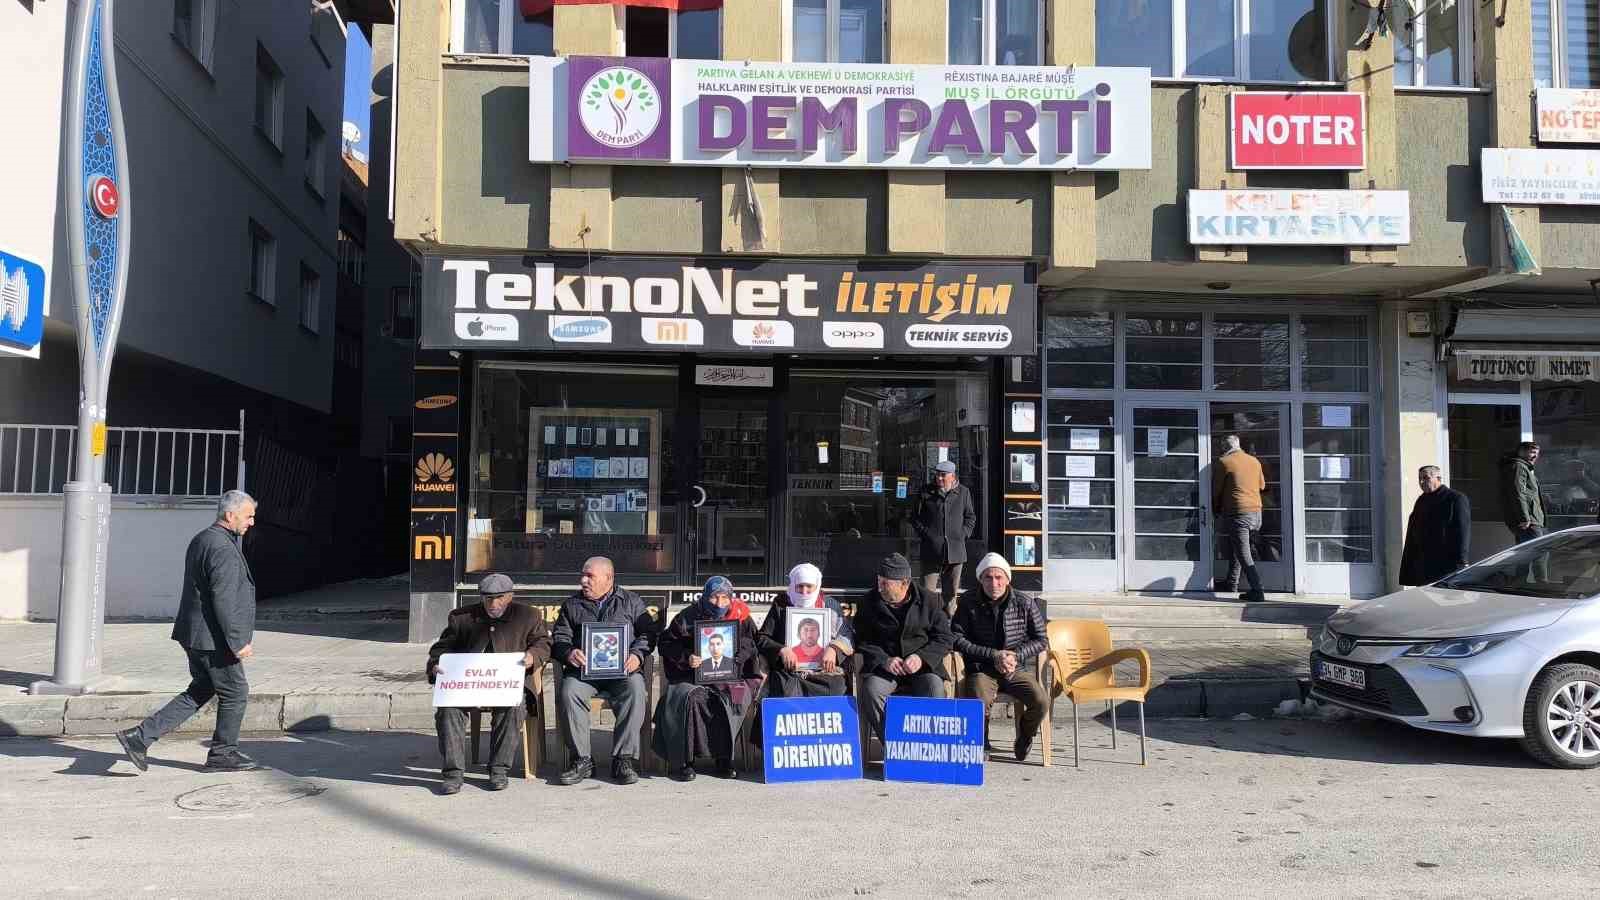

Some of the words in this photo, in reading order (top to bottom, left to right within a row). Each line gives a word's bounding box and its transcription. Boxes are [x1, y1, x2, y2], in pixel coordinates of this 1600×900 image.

[740, 69, 774, 80] GELAN
[777, 70, 785, 79] A
[698, 82, 757, 93] HALKLARIN
[759, 82, 797, 94] EŞİTLİK
[800, 84, 813, 94] VE
[815, 84, 871, 95] DEMOKRASİ
[876, 84, 914, 95] PARTİSİ
[944, 87, 979, 101] MUŞ
[986, 85, 999, 99] İL
[1005, 86, 1075, 100] ÖRGÜTÜ
[699, 95, 858, 153] DEM
[885, 83, 1112, 155] PARTİ
[596, 129, 615, 143] DEM
[1241, 114, 1357, 145] NOTER
[443, 260, 819, 318] TeknoNet
[836, 271, 1014, 322] İLETİŞİM
[484, 323, 507, 333] iPhone
[909, 329, 958, 342] TEKNİK
[961, 329, 1009, 343] SERVİS
[1549, 357, 1592, 376] NİMET
[414, 483, 455, 492] HUAWEI
[683, 592, 703, 602] HO
[465, 668, 499, 677] EVLAT
[440, 680, 520, 690] NÖBETİNDEYİZ
[775, 712, 843, 736] ANNELER
[903, 714, 931, 733] ARTIK
[933, 715, 961, 736] YETER
[773, 737, 853, 769] DİRENİYOR
[885, 740, 949, 762] YAKAMIZDAN
[950, 739, 984, 769] DÜŞÜN
